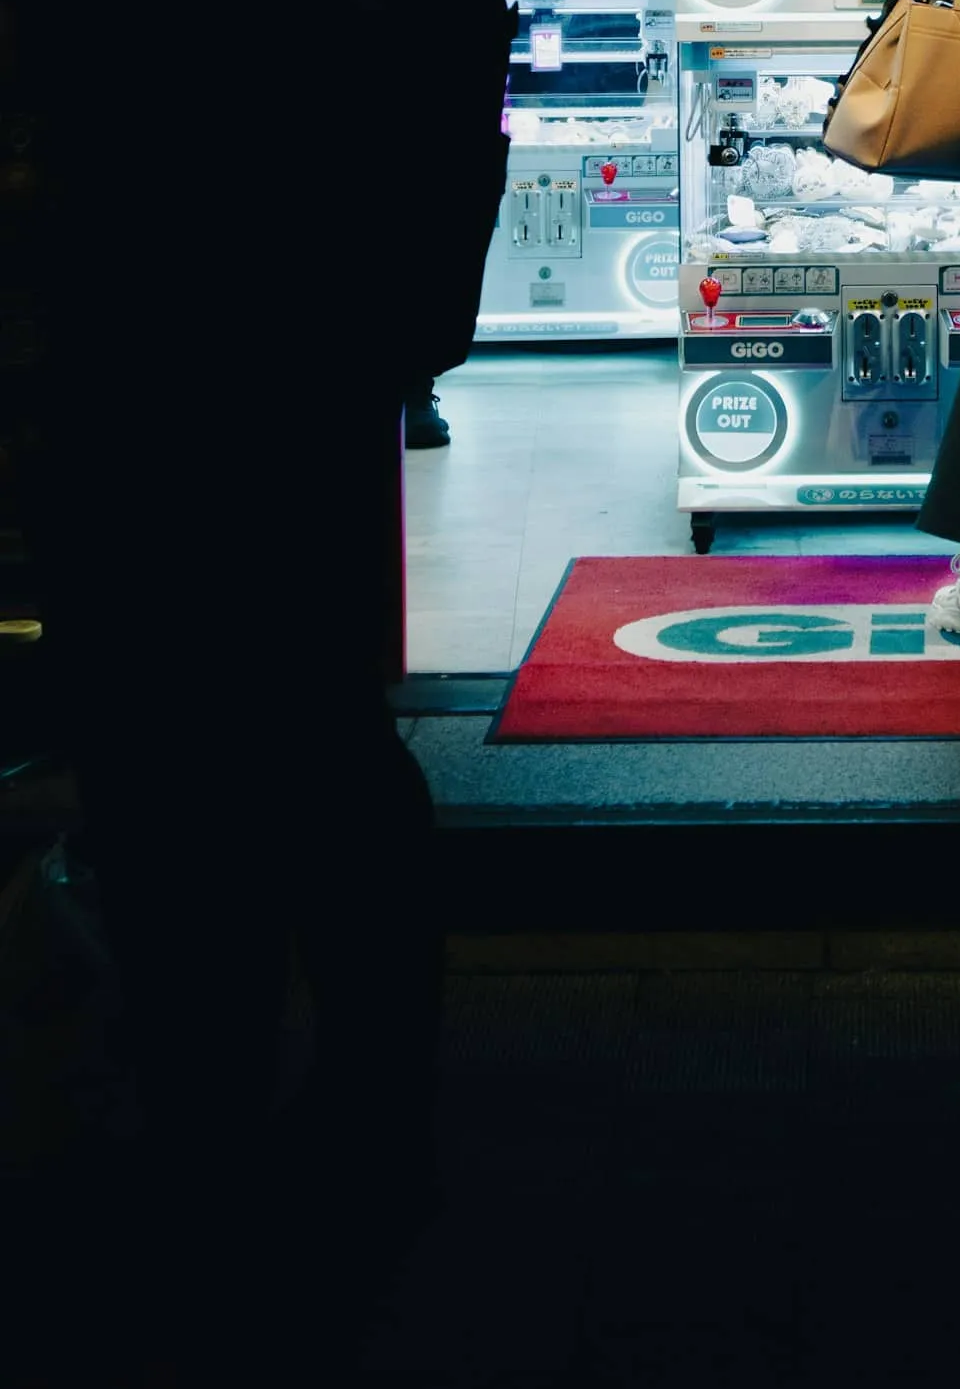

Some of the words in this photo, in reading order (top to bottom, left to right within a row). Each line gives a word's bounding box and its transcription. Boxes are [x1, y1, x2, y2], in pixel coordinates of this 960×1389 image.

[625, 211, 665, 224] GiGO
[649, 266, 676, 278] OUT
[730, 342, 784, 358] GiGO
[711, 396, 757, 411] PRIZE
[717, 414, 752, 428] OUT
